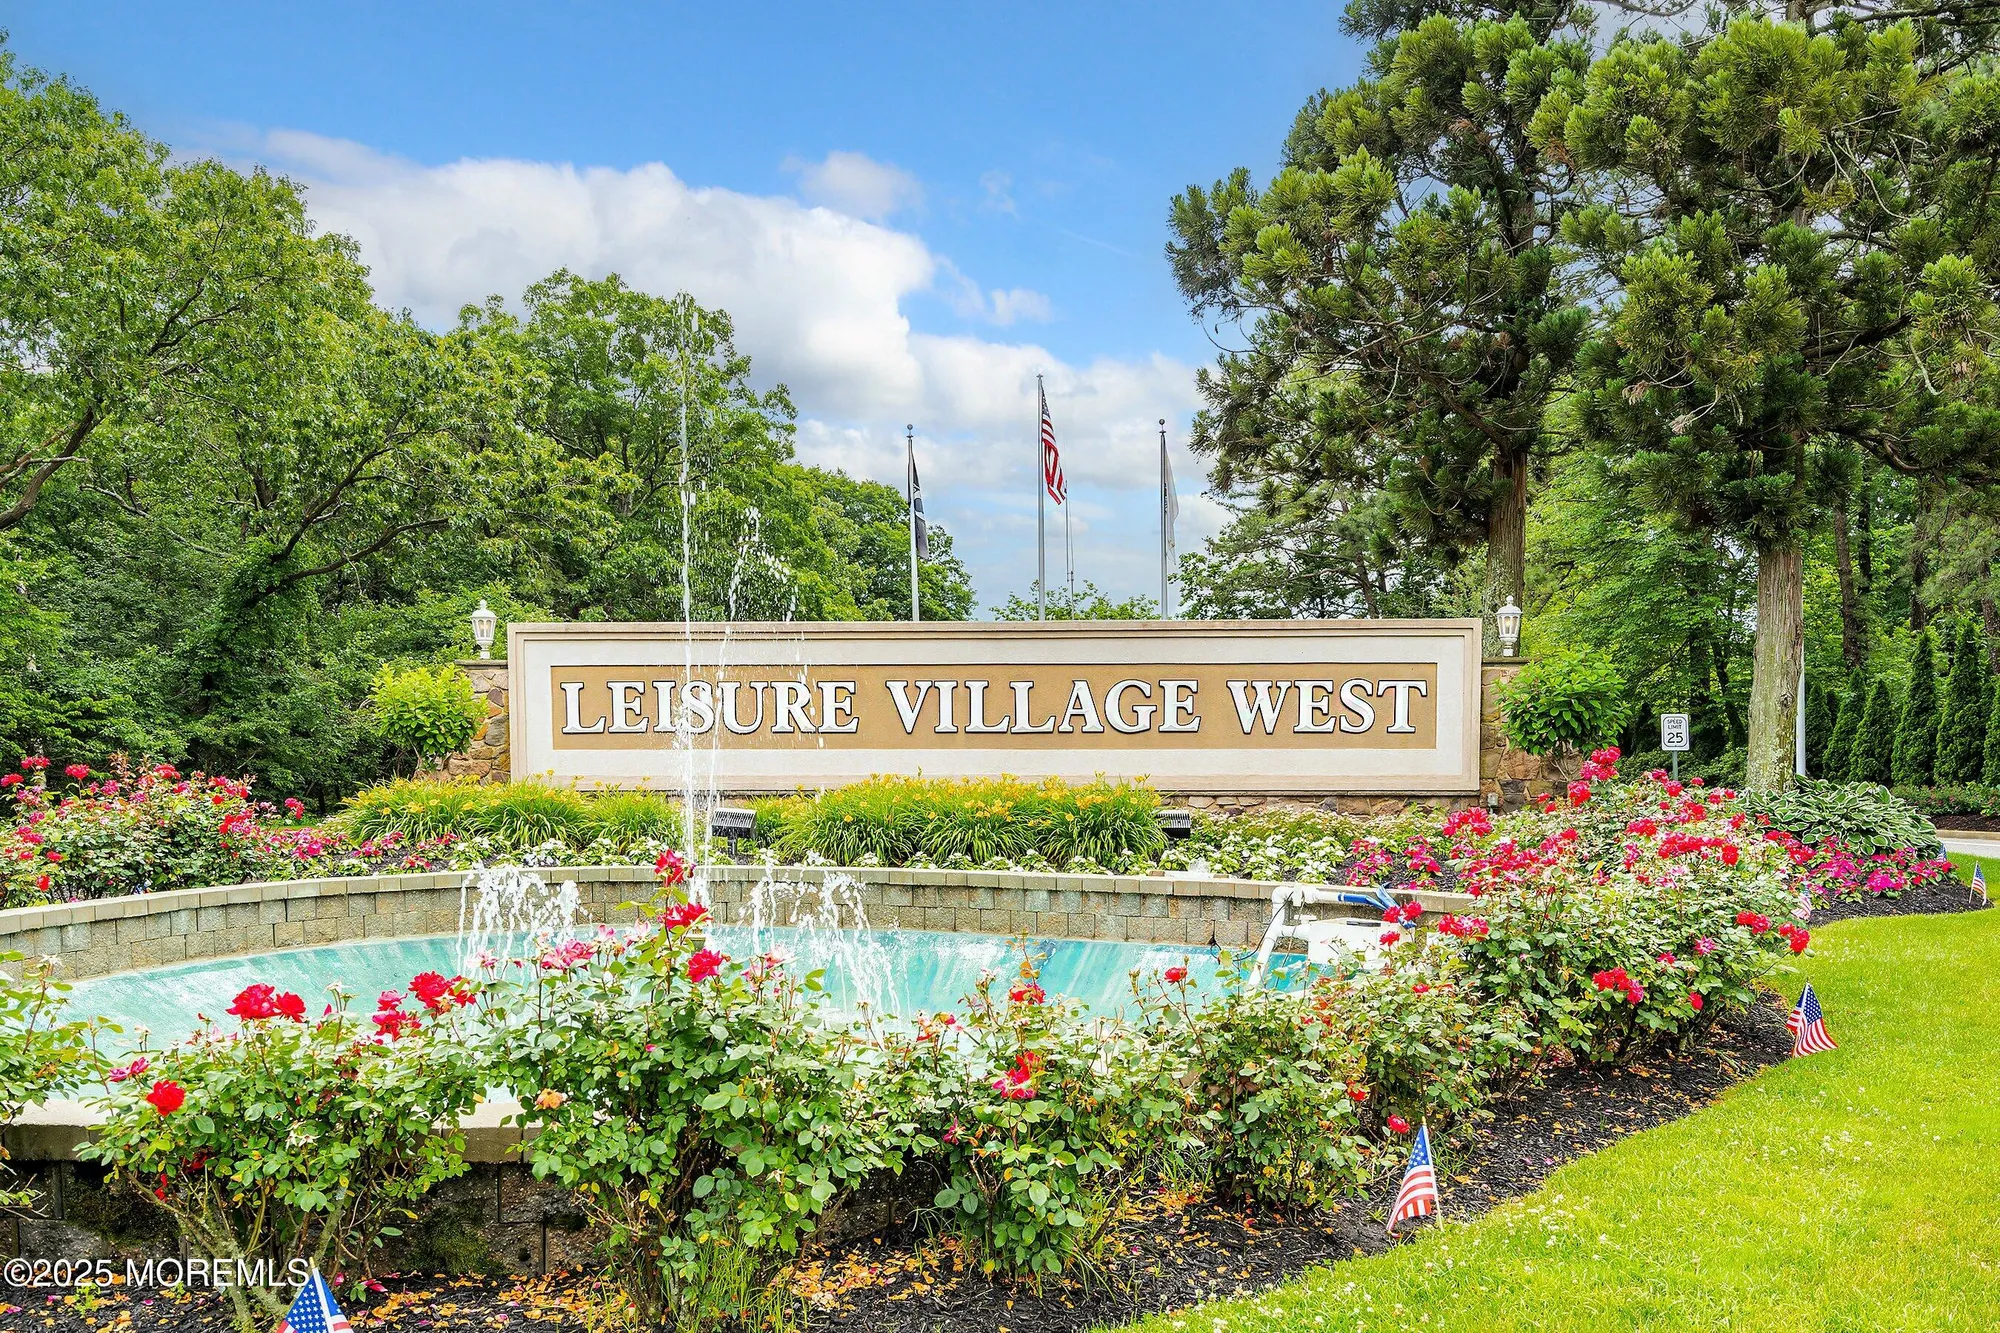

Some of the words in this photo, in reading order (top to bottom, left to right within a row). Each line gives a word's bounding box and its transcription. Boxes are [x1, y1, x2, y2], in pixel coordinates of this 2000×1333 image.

[560, 680, 860, 735] LEISURE
[885, 679, 1202, 735] VILLAGE
[1227, 678, 1428, 735] WEST
[1667, 732, 1684, 744] 25
